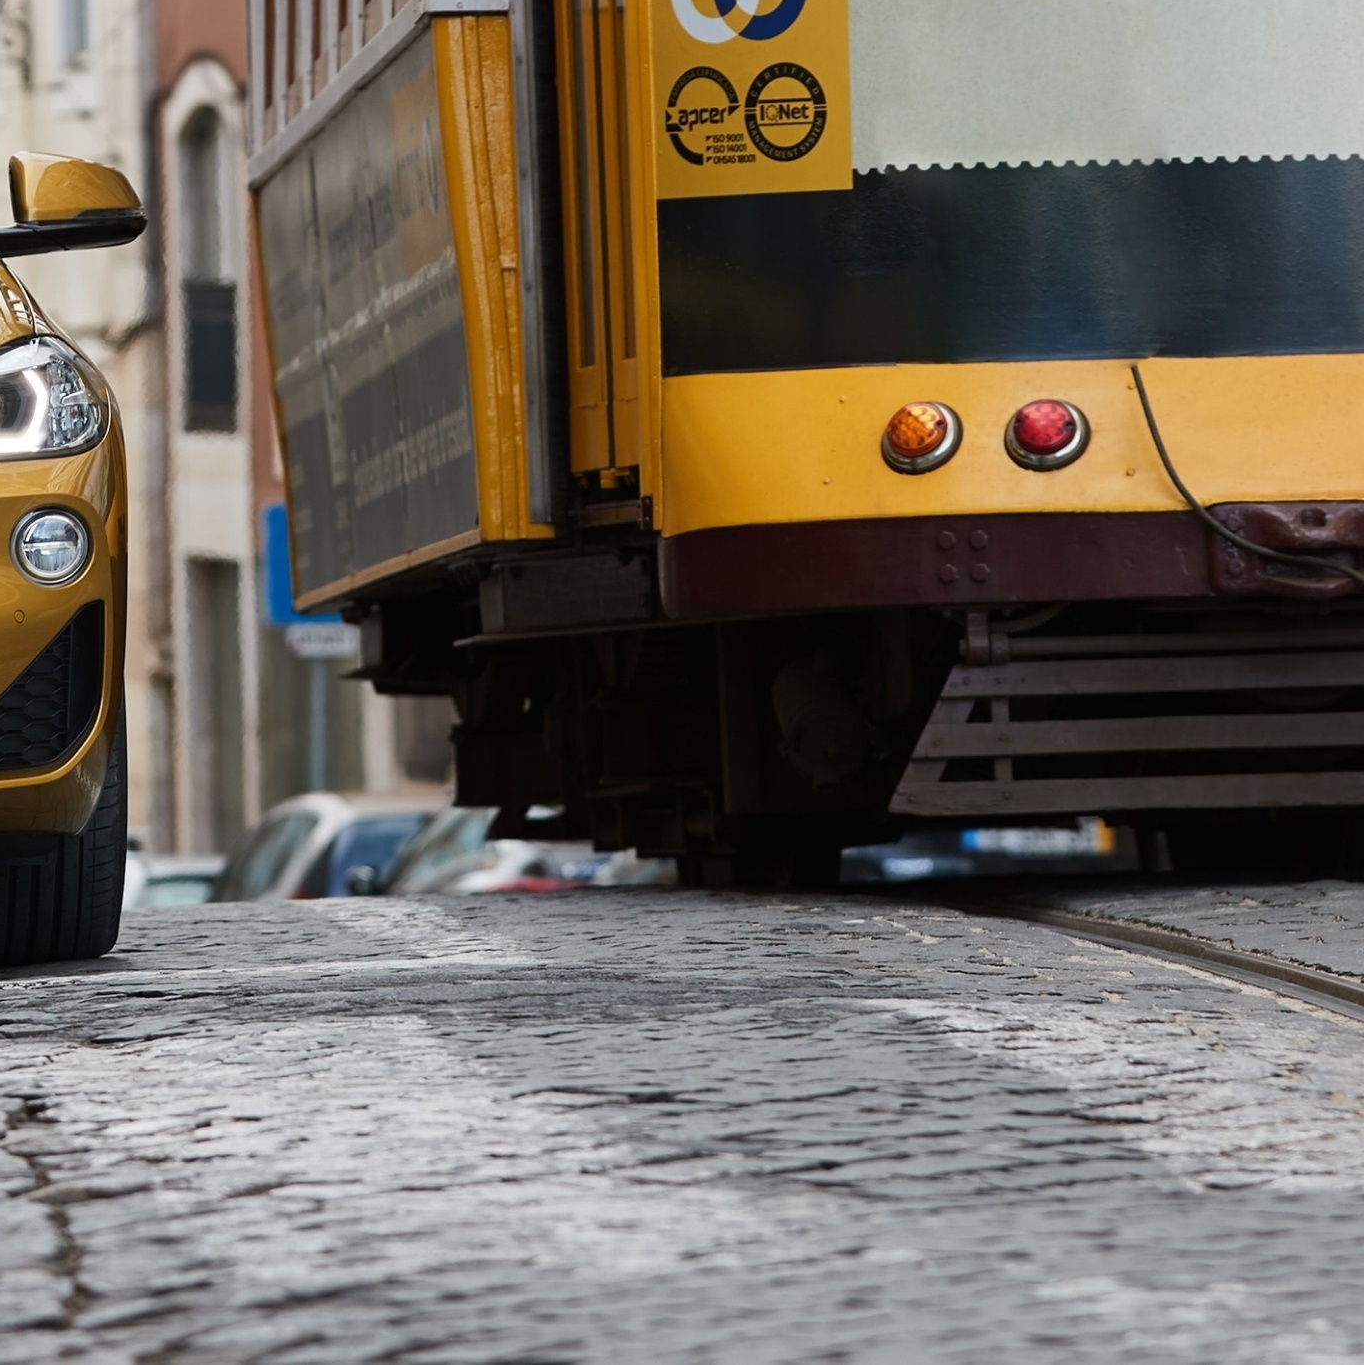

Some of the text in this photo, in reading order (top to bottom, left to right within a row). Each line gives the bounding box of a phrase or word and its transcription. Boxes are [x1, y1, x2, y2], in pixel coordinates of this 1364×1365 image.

[750, 66, 820, 98] CERTIFIED
[678, 107, 726, 131] apcer
[759, 104, 809, 123] IQNet
[713, 133, 744, 143] ISO 9001
[713, 143, 747, 154] ISO 14001
[748, 117, 823, 160] MANAGEMENT SYSTEM
